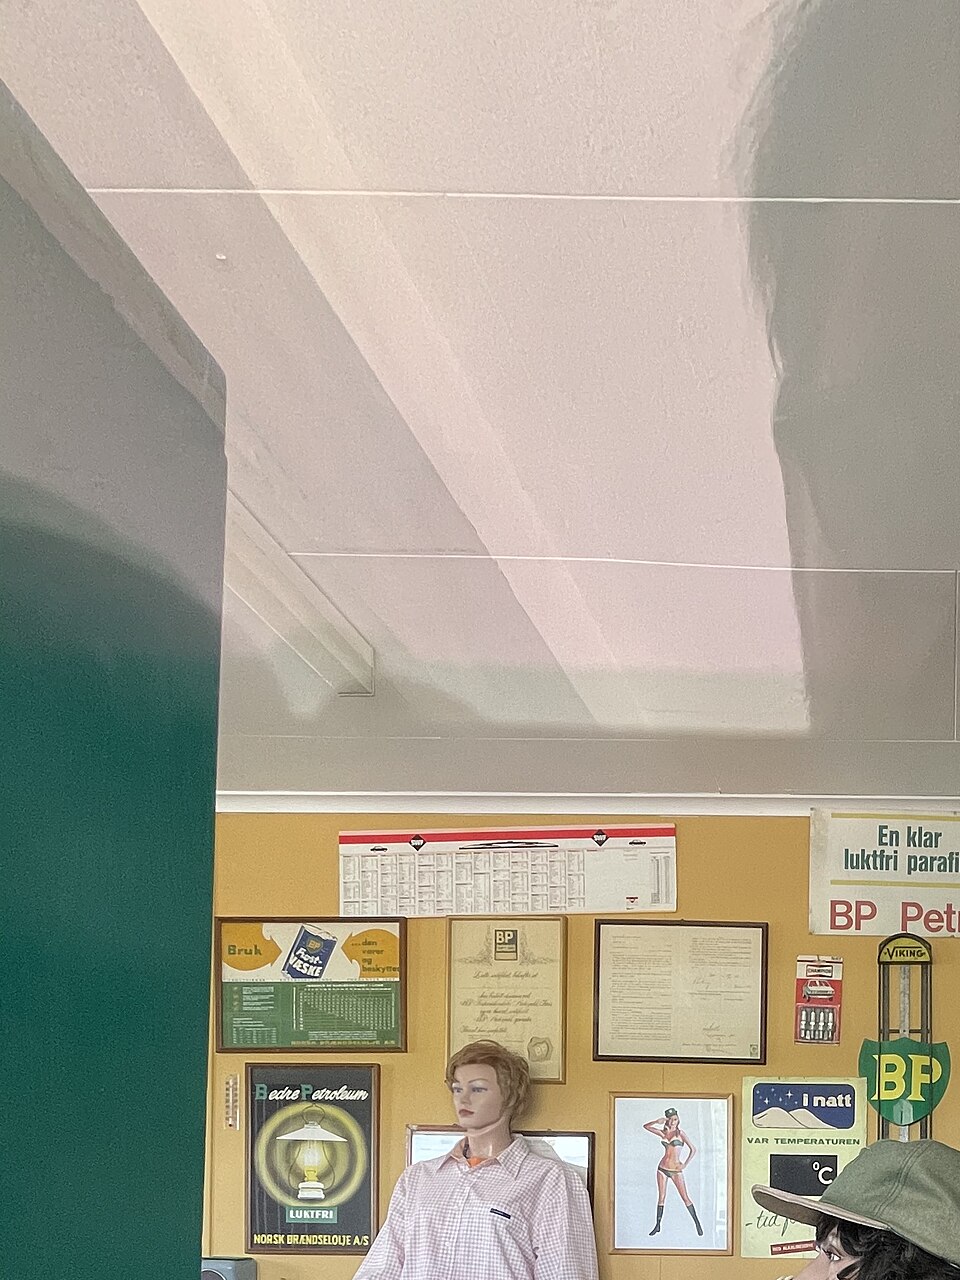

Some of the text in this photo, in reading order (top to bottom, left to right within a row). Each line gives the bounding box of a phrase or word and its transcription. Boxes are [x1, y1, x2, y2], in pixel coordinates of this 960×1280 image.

[878, 824, 943, 849] En klar
[843, 848, 898, 872] luktfri
[829, 899, 878, 931] BP
[495, 930, 514, 944] BP
[226, 944, 263, 956] Bruk
[886, 946, 924, 961] VIKING
[289, 953, 323, 978] VÆSKE
[870, 1053, 943, 1102] BP
[254, 1083, 369, 1101] Bedre Petroleum
[812, 1093, 852, 1108] natt
[746, 1137, 861, 1146] VAR TEMPERATUREN
[288, 1209, 334, 1220] LUKTFRI
[253, 1233, 369, 1247] NORSK BRÆNDSELOLJE A/S
